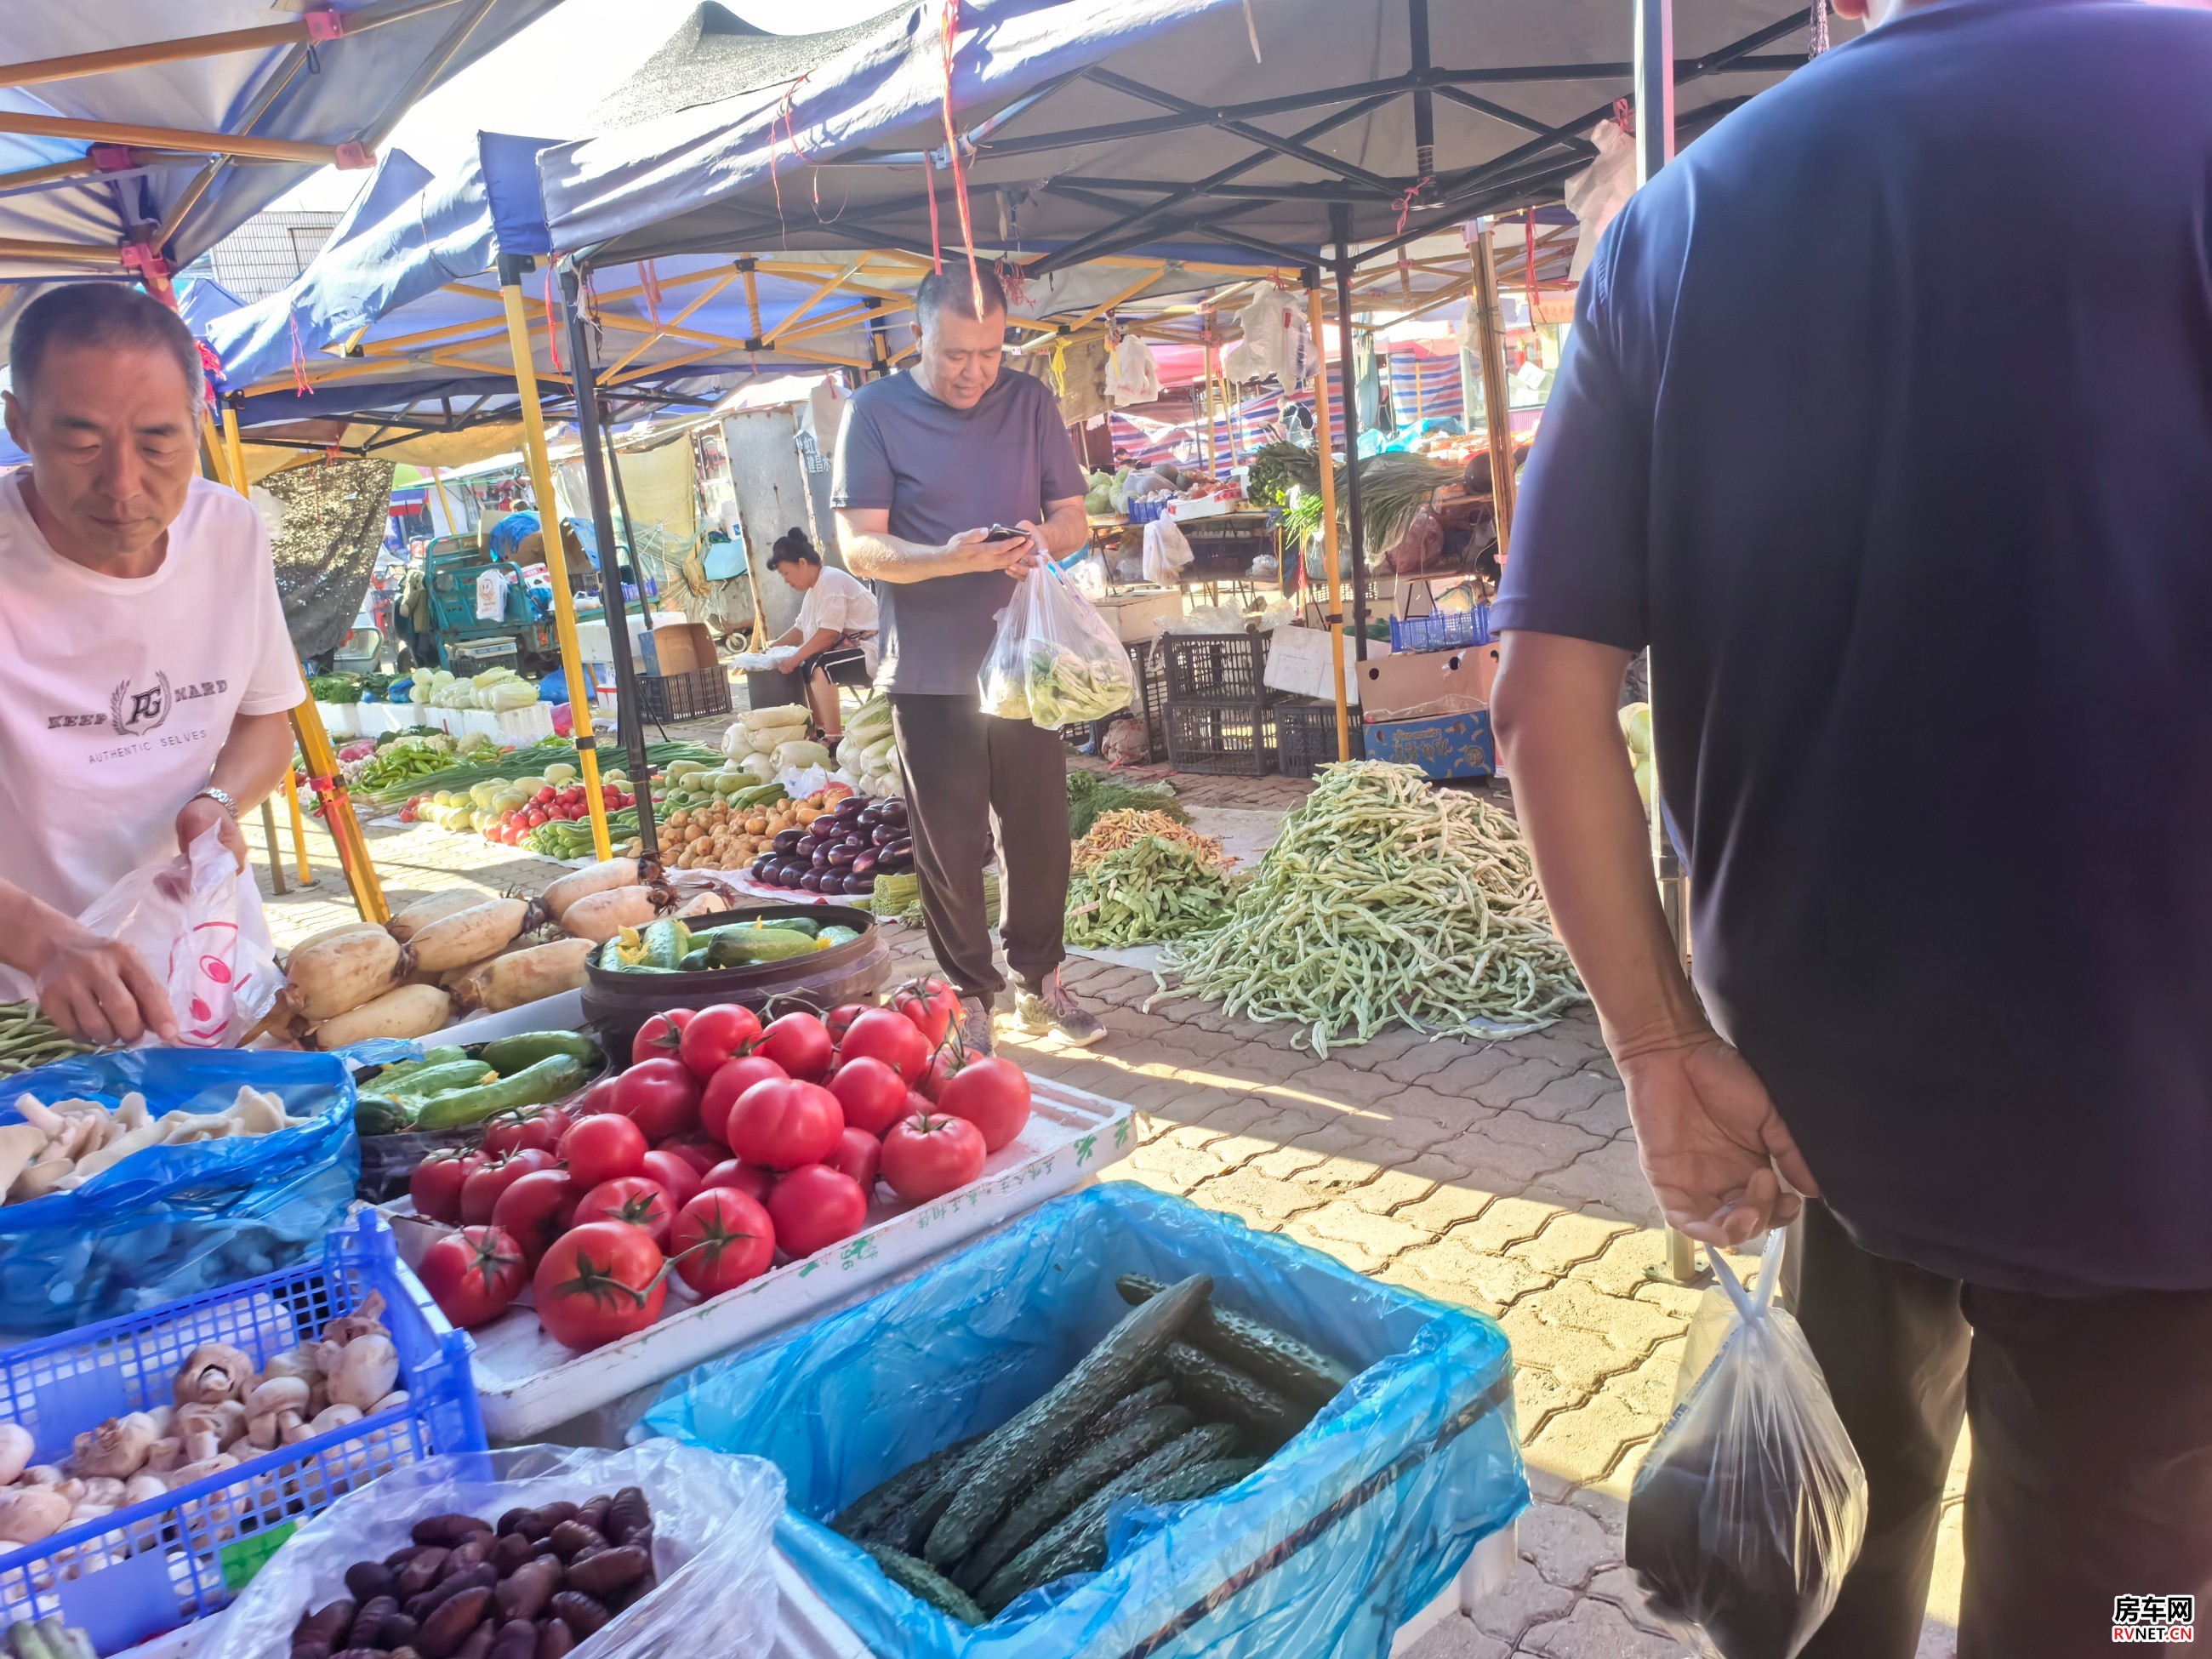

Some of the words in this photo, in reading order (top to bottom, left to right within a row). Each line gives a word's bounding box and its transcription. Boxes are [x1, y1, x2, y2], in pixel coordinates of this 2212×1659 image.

[48, 713, 108, 729] KEEP
[174, 679, 228, 703] HARD
[88, 742, 151, 765] AUTHENTIC
[160, 729, 208, 748] SELVES
